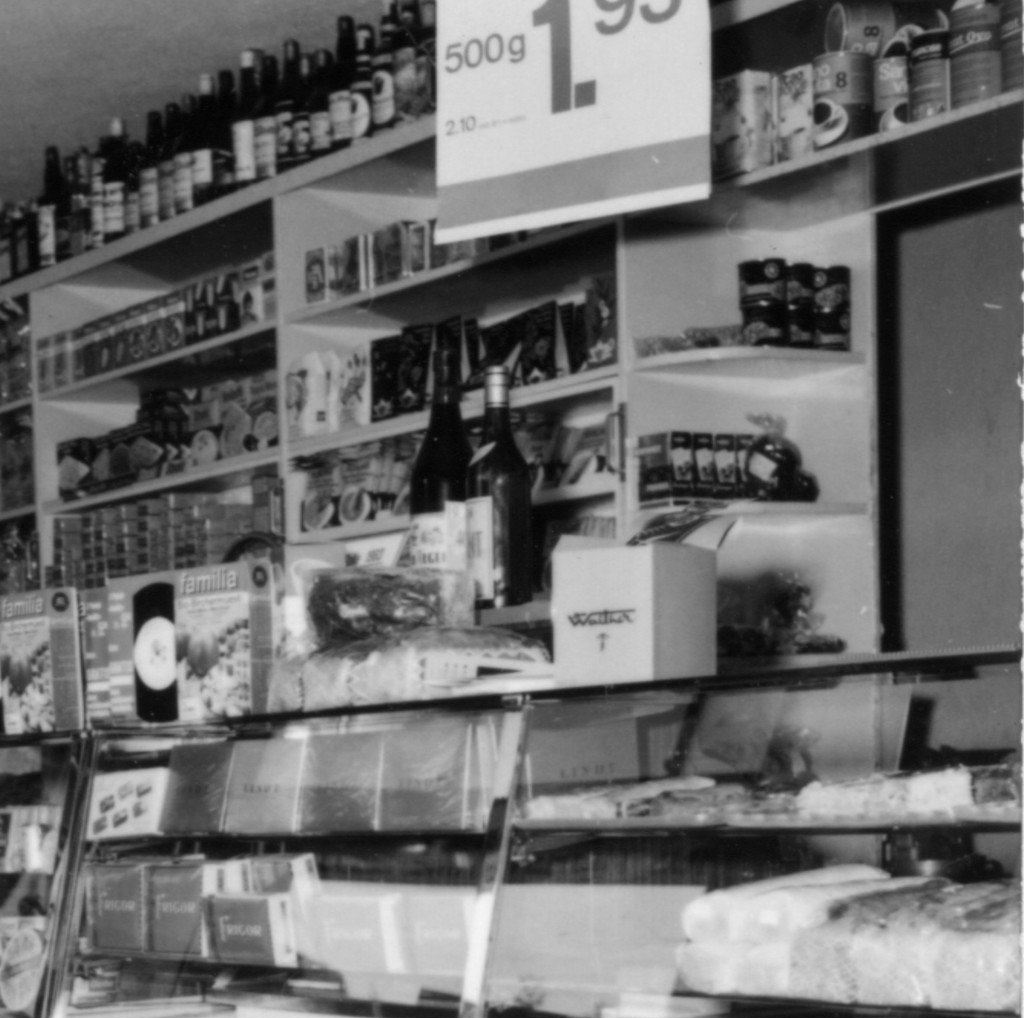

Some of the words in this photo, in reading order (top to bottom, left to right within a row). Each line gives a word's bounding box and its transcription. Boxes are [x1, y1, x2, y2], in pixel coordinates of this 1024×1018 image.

[836, 71, 848, 89] 8
[179, 567, 238, 595] familia
[2, 593, 44, 619] familia
